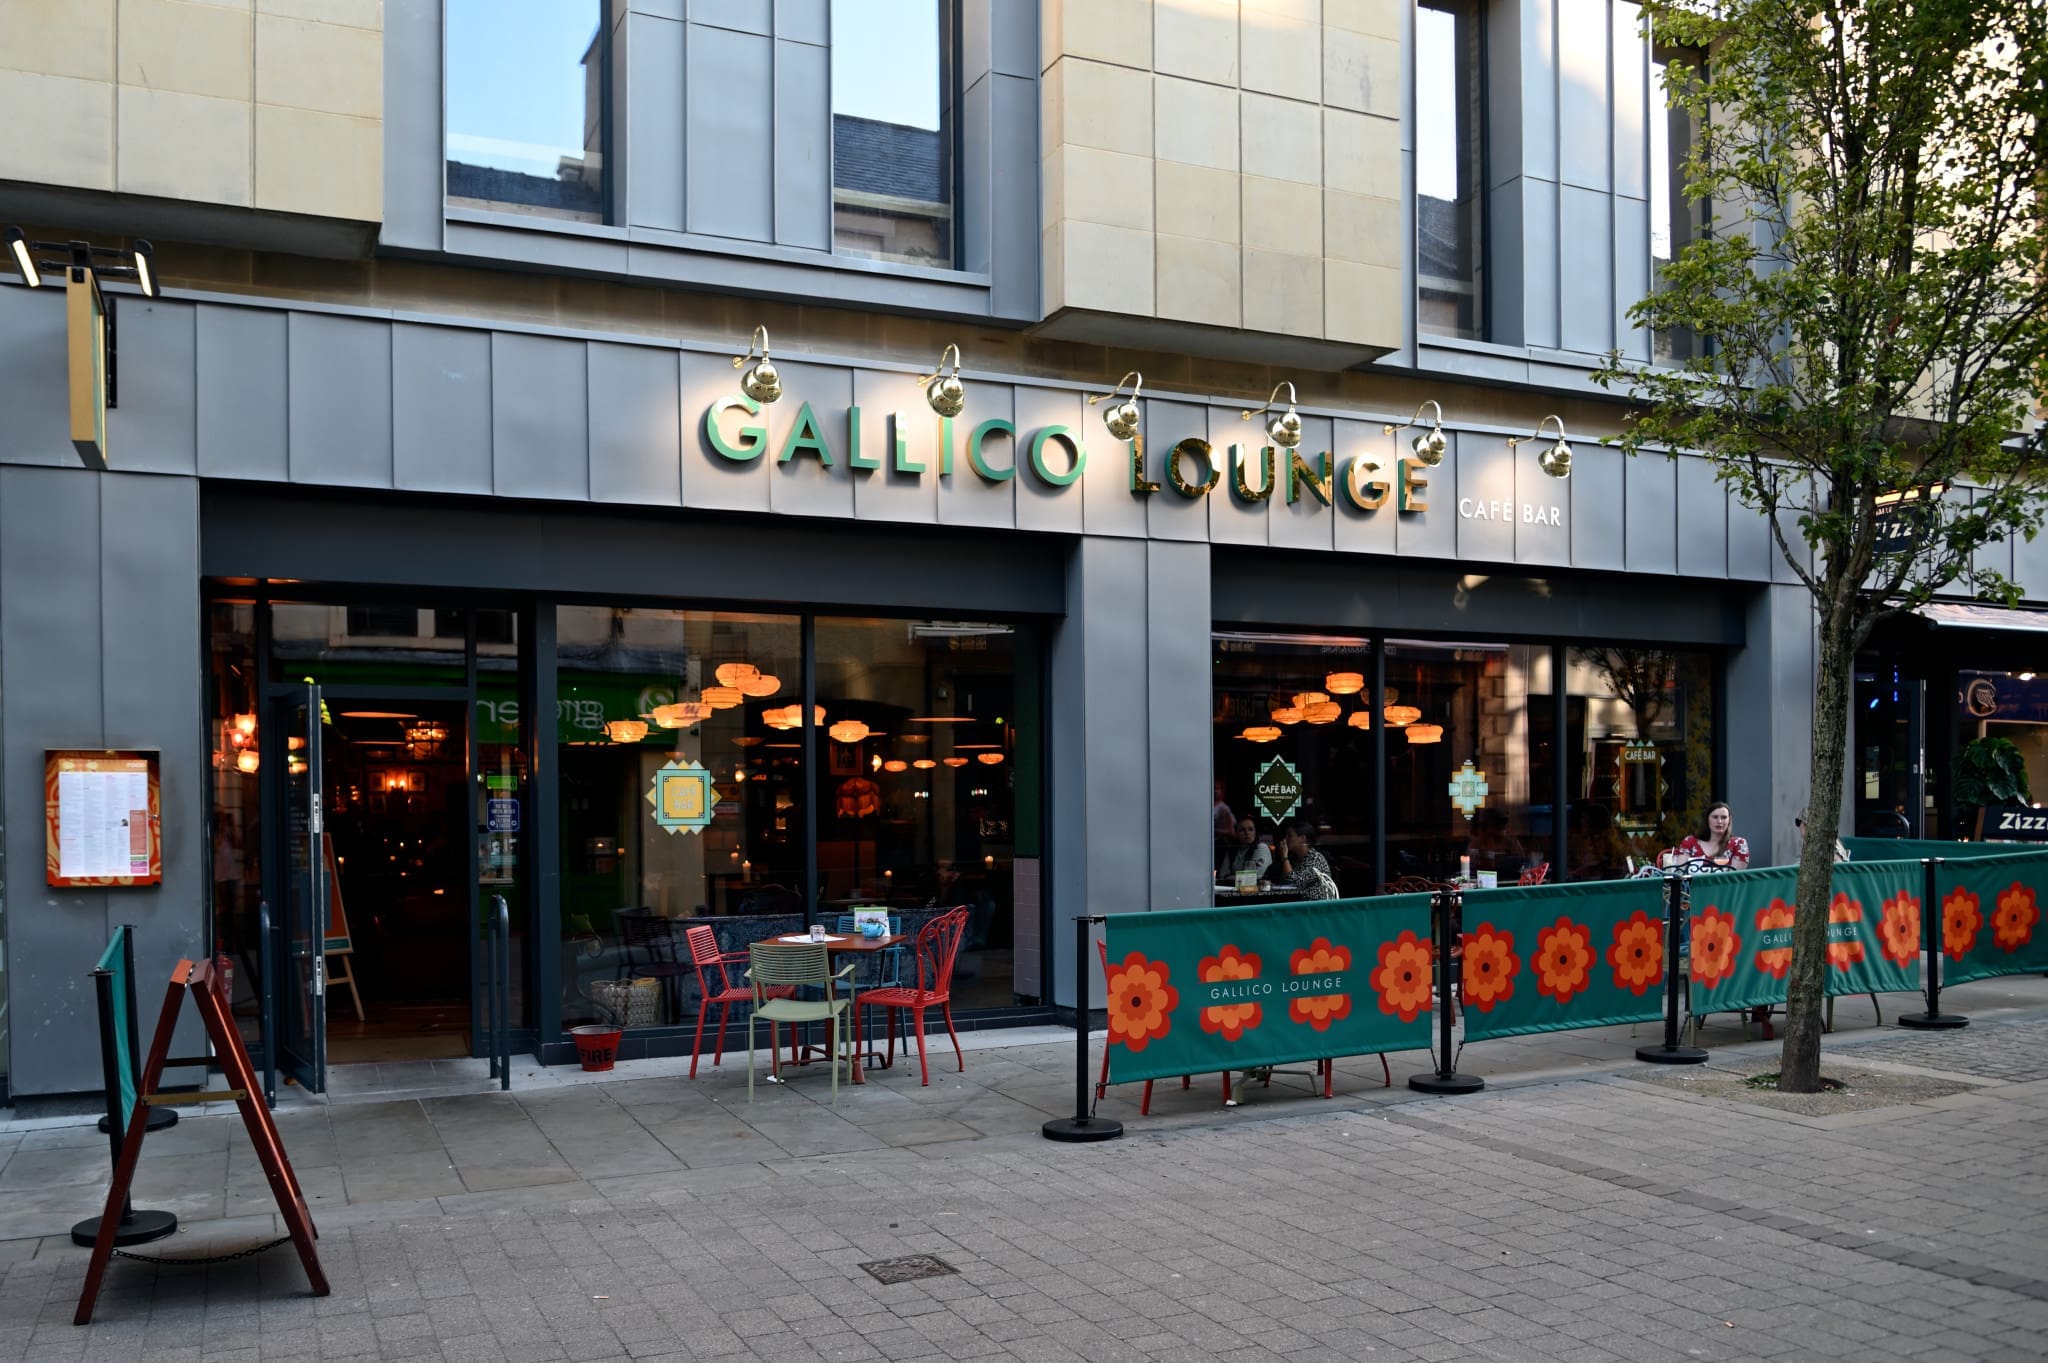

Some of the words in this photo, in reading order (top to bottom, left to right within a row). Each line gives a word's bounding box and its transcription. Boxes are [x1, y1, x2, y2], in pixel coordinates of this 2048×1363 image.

[705, 394, 1088, 488] GALLICO
[1130, 435, 1428, 512] LOUNGE
[1459, 497, 1513, 522] CAFÉ
[1523, 503, 1561, 527] BAR
[1643, 750, 1656, 760] BAR
[1258, 783, 1279, 794] CAFÉ
[1280, 785, 1297, 794] BAR
[1999, 812, 2048, 830] Zizz
[1763, 933, 1793, 945] GALLI
[1827, 926, 1858, 937] UNGE
[1210, 983, 1272, 1000] GALLICO
[1282, 977, 1342, 993] LOUNGE
[580, 1047, 612, 1062] FIRE
